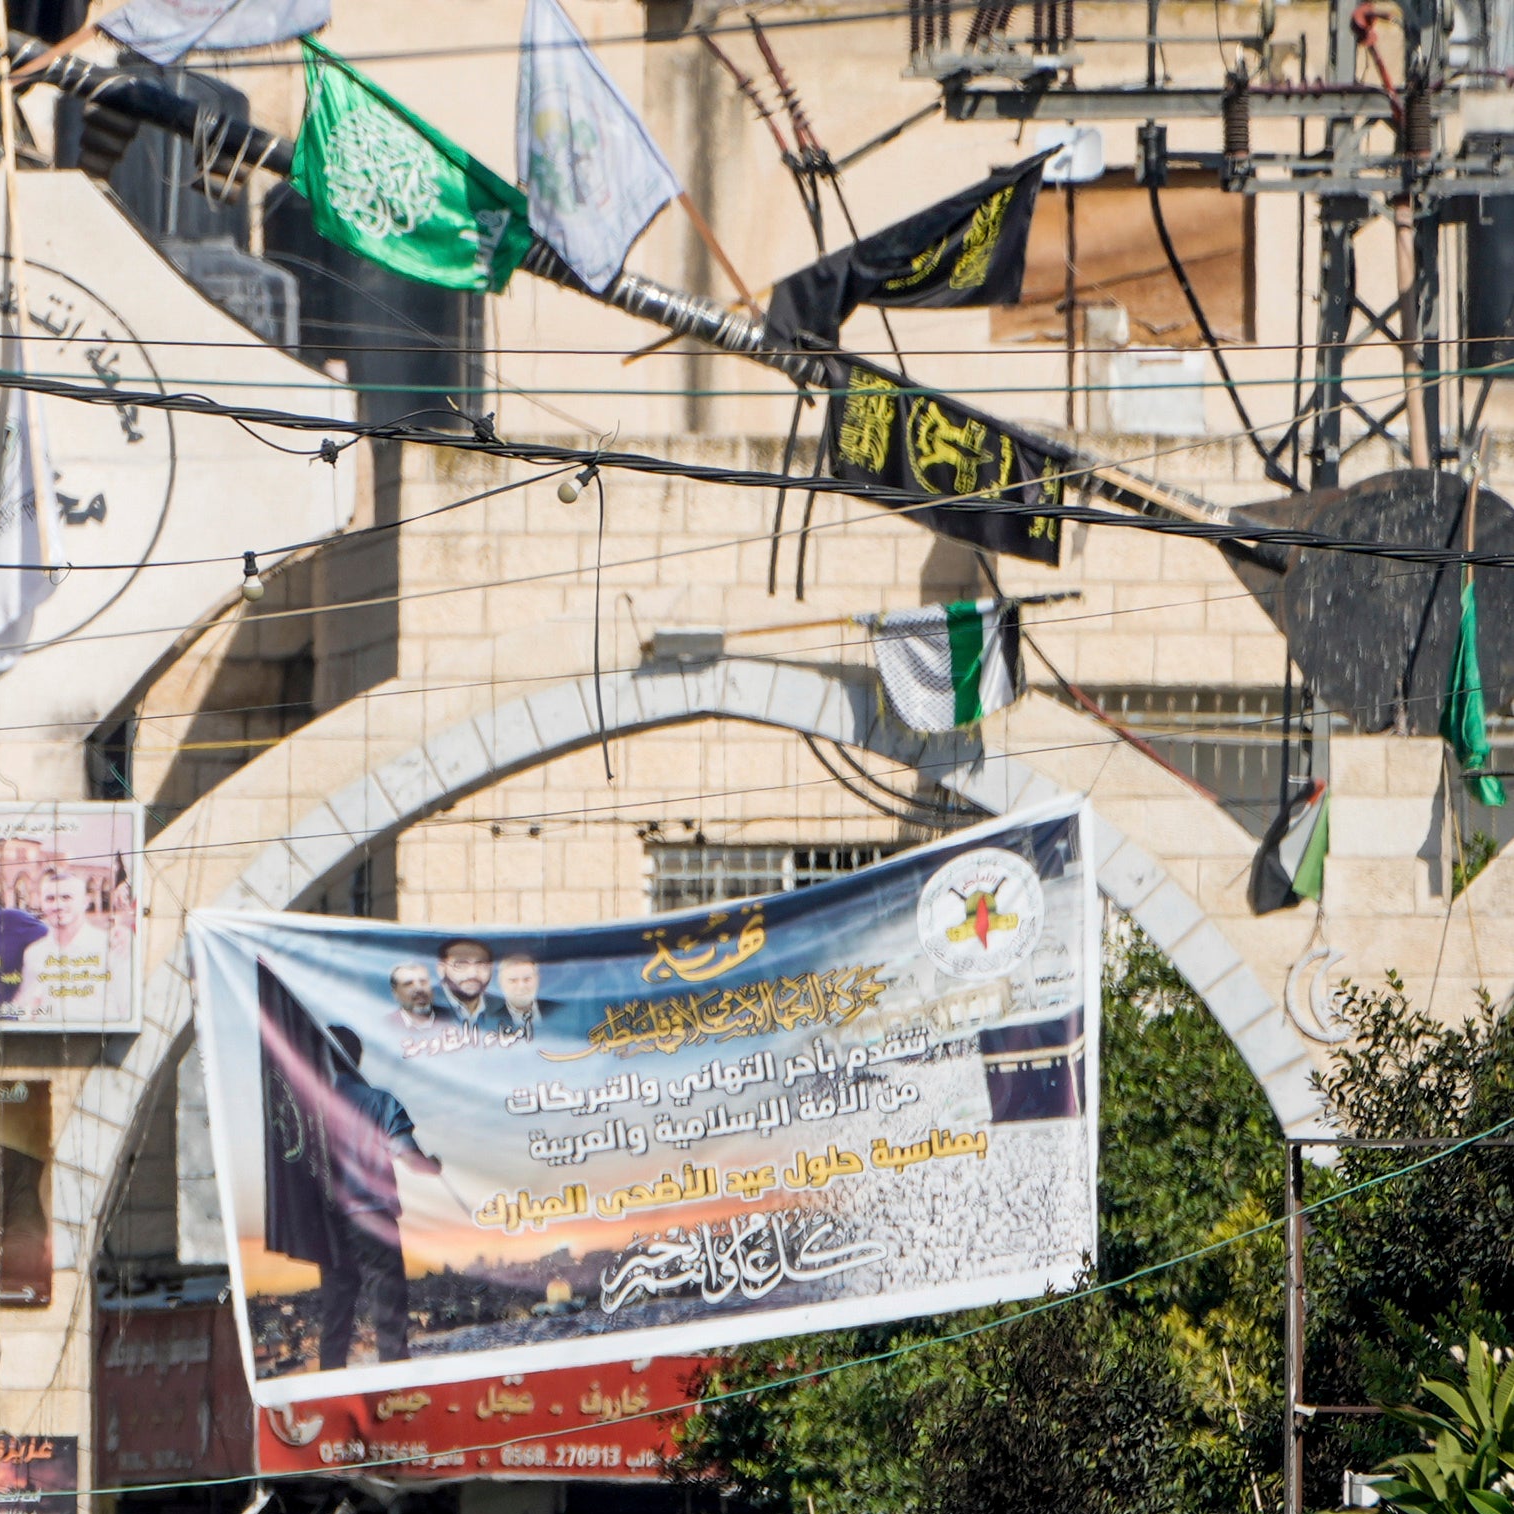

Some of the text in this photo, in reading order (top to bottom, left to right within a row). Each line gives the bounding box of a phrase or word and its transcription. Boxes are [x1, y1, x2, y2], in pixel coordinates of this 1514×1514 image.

[641, 901, 768, 984] تهنئة
[667, 1051, 774, 1103] التهاني
[782, 1036, 839, 1089] بأحر
[504, 1071, 663, 1117] والتبريكات
[528, 1076, 921, 1167] من الأمة الإسلامية والعربية
[473, 1125, 989, 1235] بمناسبة حلول عيد الأضحى المبارك
[579, 1380, 651, 1423] خاروف
